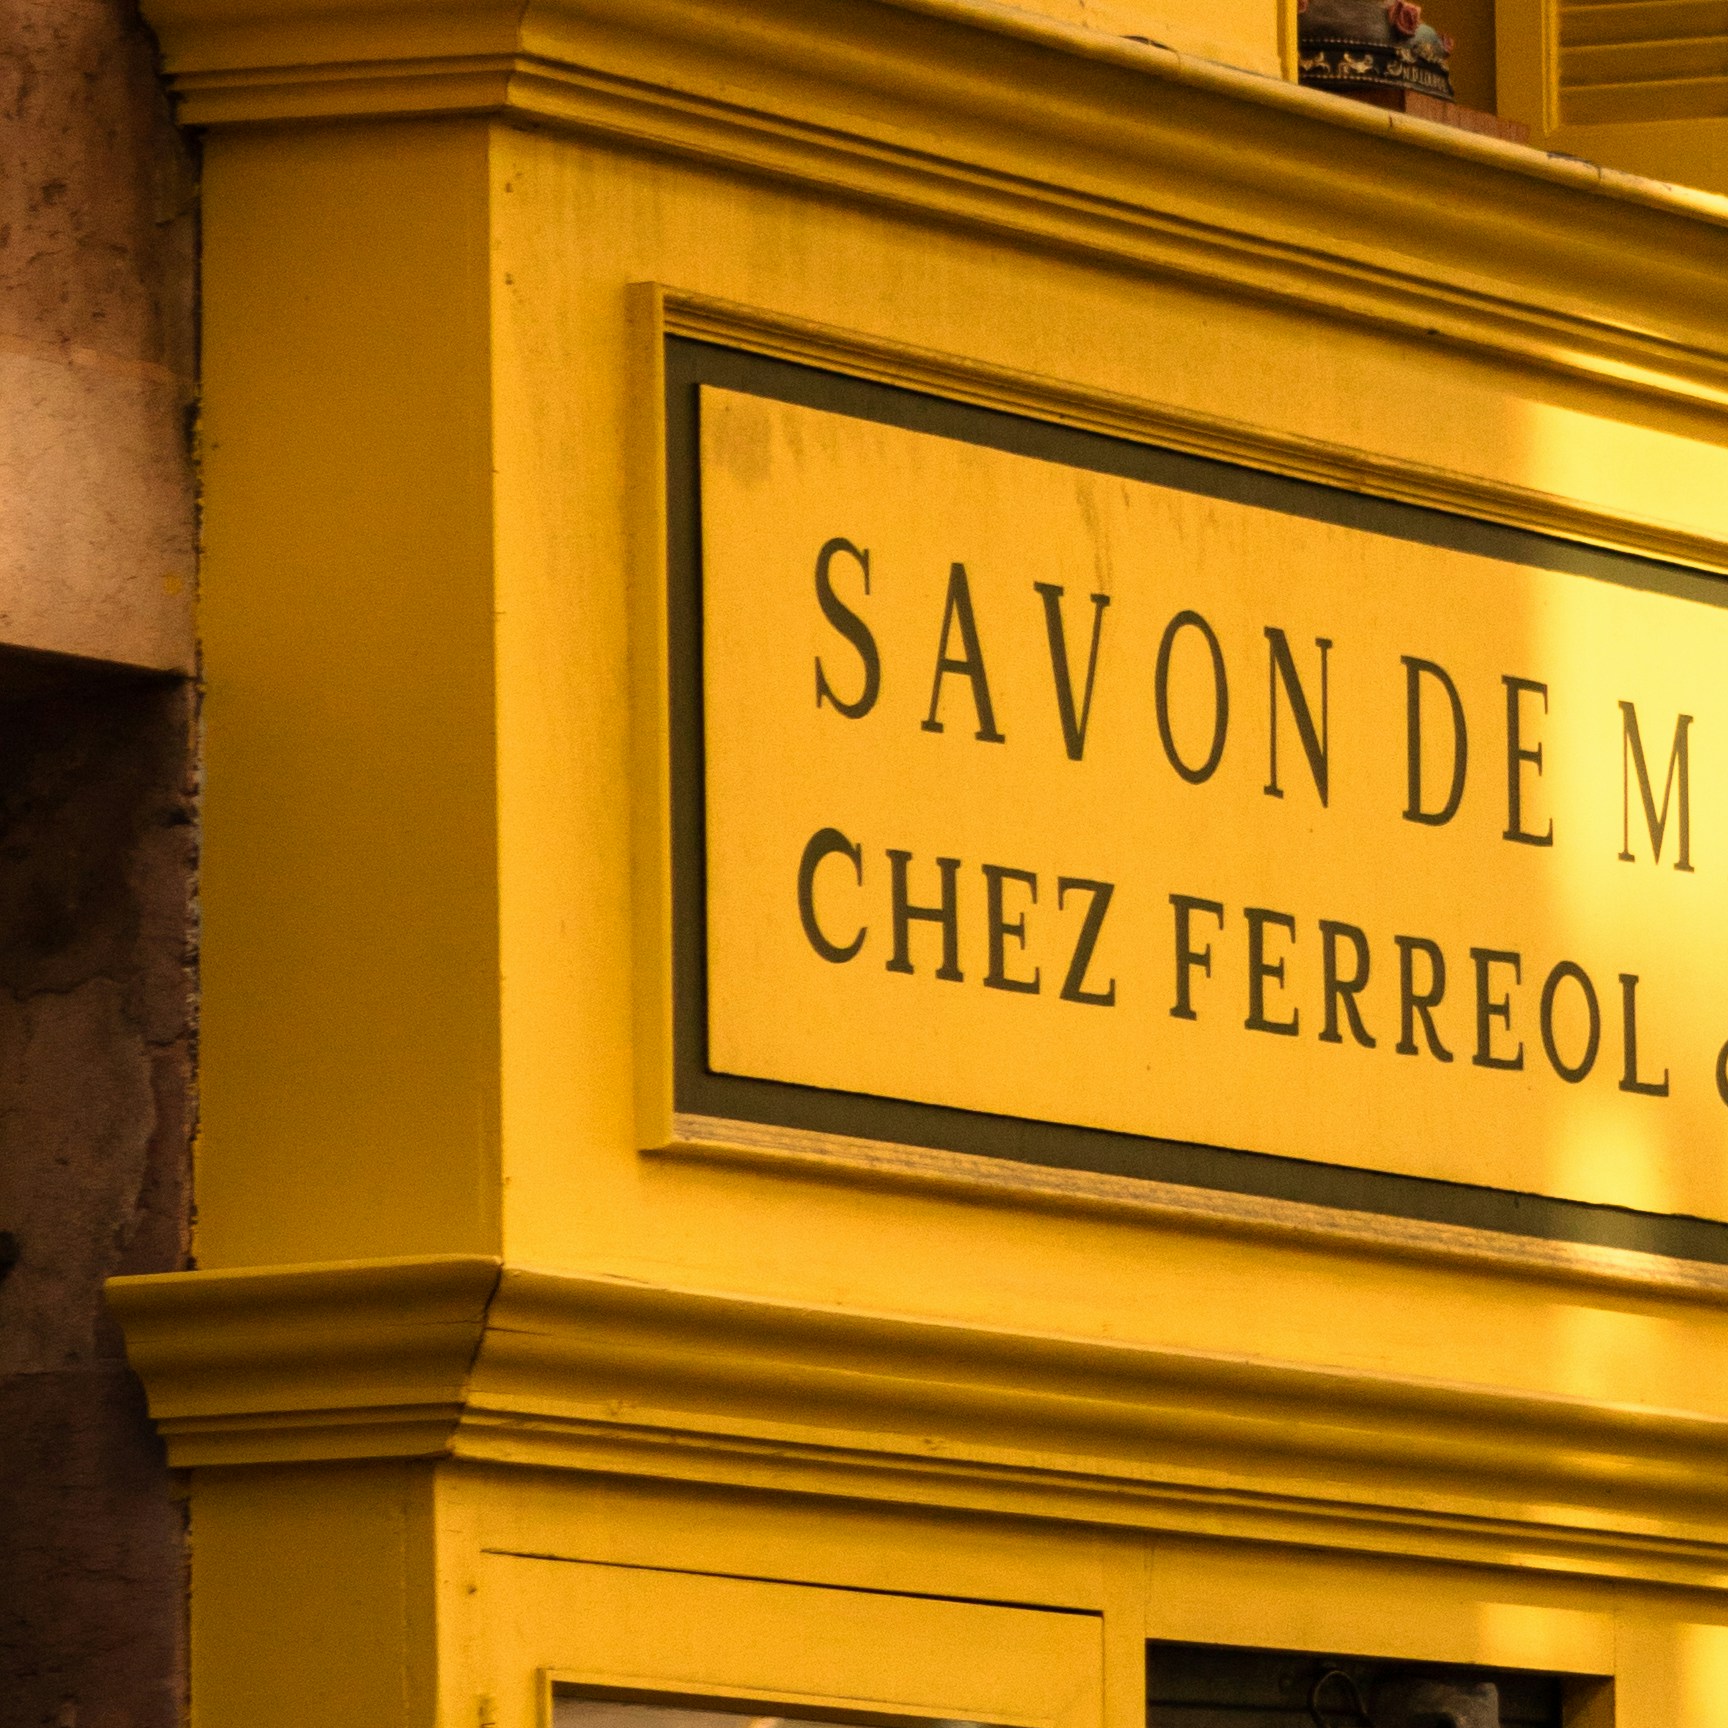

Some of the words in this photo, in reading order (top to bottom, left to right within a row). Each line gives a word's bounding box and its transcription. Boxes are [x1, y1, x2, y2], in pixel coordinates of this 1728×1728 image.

[813, 537, 1334, 808] SAVON
[1400, 655, 1554, 848] DE
[797, 827, 1117, 1008] CHEZ
[1169, 893, 1671, 1099] FERREOL
